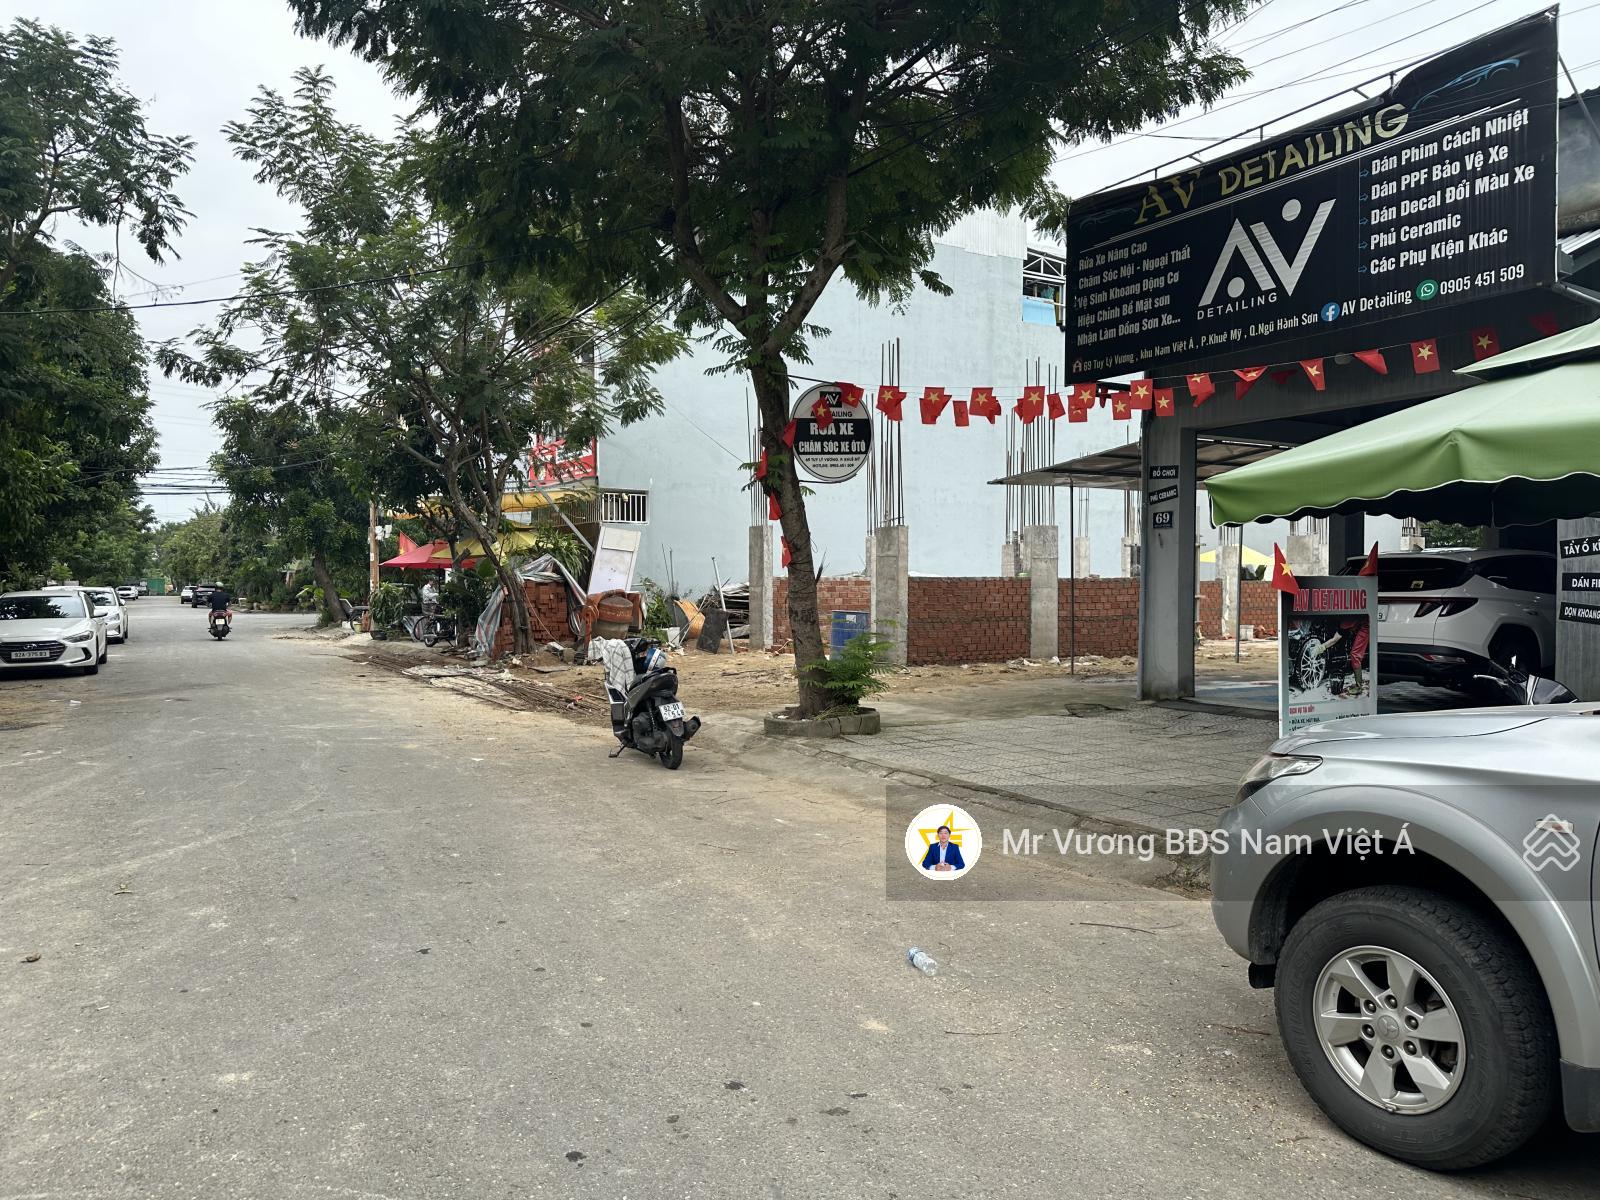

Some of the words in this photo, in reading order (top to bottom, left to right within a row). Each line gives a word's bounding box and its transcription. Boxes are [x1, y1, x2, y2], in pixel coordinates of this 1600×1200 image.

[1371, 156, 1398, 175] Dán
[1401, 142, 1438, 165] Phim
[1442, 125, 1481, 151] Cách
[1485, 108, 1529, 138] Nhiệt
[1134, 168, 1204, 225] AV
[1218, 103, 1409, 195] DETAILING
[1371, 180, 1397, 200] Dán
[1401, 168, 1429, 191] PPF
[1432, 159, 1461, 182] Bảo
[1465, 150, 1484, 171] Vệ
[1488, 144, 1509, 164] Xe
[1371, 205, 1397, 225] Dán
[1400, 190, 1441, 217] Decal
[1445, 179, 1470, 204] Đổi
[1475, 172, 1509, 195] Màu
[1514, 164, 1535, 184] Xe
[1370, 228, 1396, 250] Phủ
[1400, 213, 1461, 242] Ceramic
[1079, 256, 1094, 271] Rửa
[1095, 254, 1106, 267] Xe
[1131, 242, 1148, 256] Cao
[1102, 269, 1118, 283] Sóc
[1120, 263, 1135, 279] Nội
[1142, 255, 1169, 272] Ngoại
[1171, 244, 1191, 264] Thất
[1370, 256, 1396, 275] Các
[1400, 248, 1427, 268] Phụ
[1430, 239, 1464, 260] Kiện
[1468, 226, 1508, 250] Khác
[1090, 291, 1107, 305] Sinh
[1109, 285, 1141, 300] Khoang
[1142, 277, 1165, 292] Động
[1167, 270, 1180, 284] Cơ
[1440, 275, 1471, 295] 0905
[1475, 270, 1496, 288] 451
[1500, 263, 1525, 283] 509
[1078, 313, 1095, 327] Hiệu
[1135, 297, 1152, 313] Mặt
[1197, 292, 1278, 320] DETAILING
[1341, 300, 1356, 317] AV
[1359, 289, 1413, 312] Detailing
[1077, 331, 1097, 346] Nhận
[1099, 326, 1116, 341] Làm
[1142, 316, 1159, 331] Sơn
[1083, 361, 1092, 371] 69
[1140, 349, 1153, 360] khu
[1155, 345, 1170, 357] Nam
[1172, 340, 1187, 353] Việt
[1188, 336, 1194, 349] Á
[1230, 328, 1242, 341] Mỹ
[1277, 315, 1299, 330] Hành
[1301, 311, 1318, 326] Sơn
[839, 422, 855, 436] XE
[799, 440, 821, 453] CHĂM
[823, 440, 839, 453] SÓC
[841, 441, 850, 453] XE
[851, 440, 866, 453] ÔTÔ
[1155, 512, 1170, 524] 69
[1564, 540, 1580, 555] TẨY
[1581, 538, 1590, 552] Ố
[1571, 576, 1590, 588] DÁN
[1293, 589, 1310, 612] AV
[1312, 589, 1367, 612] DETAILING
[1564, 606, 1577, 618] DỌN
